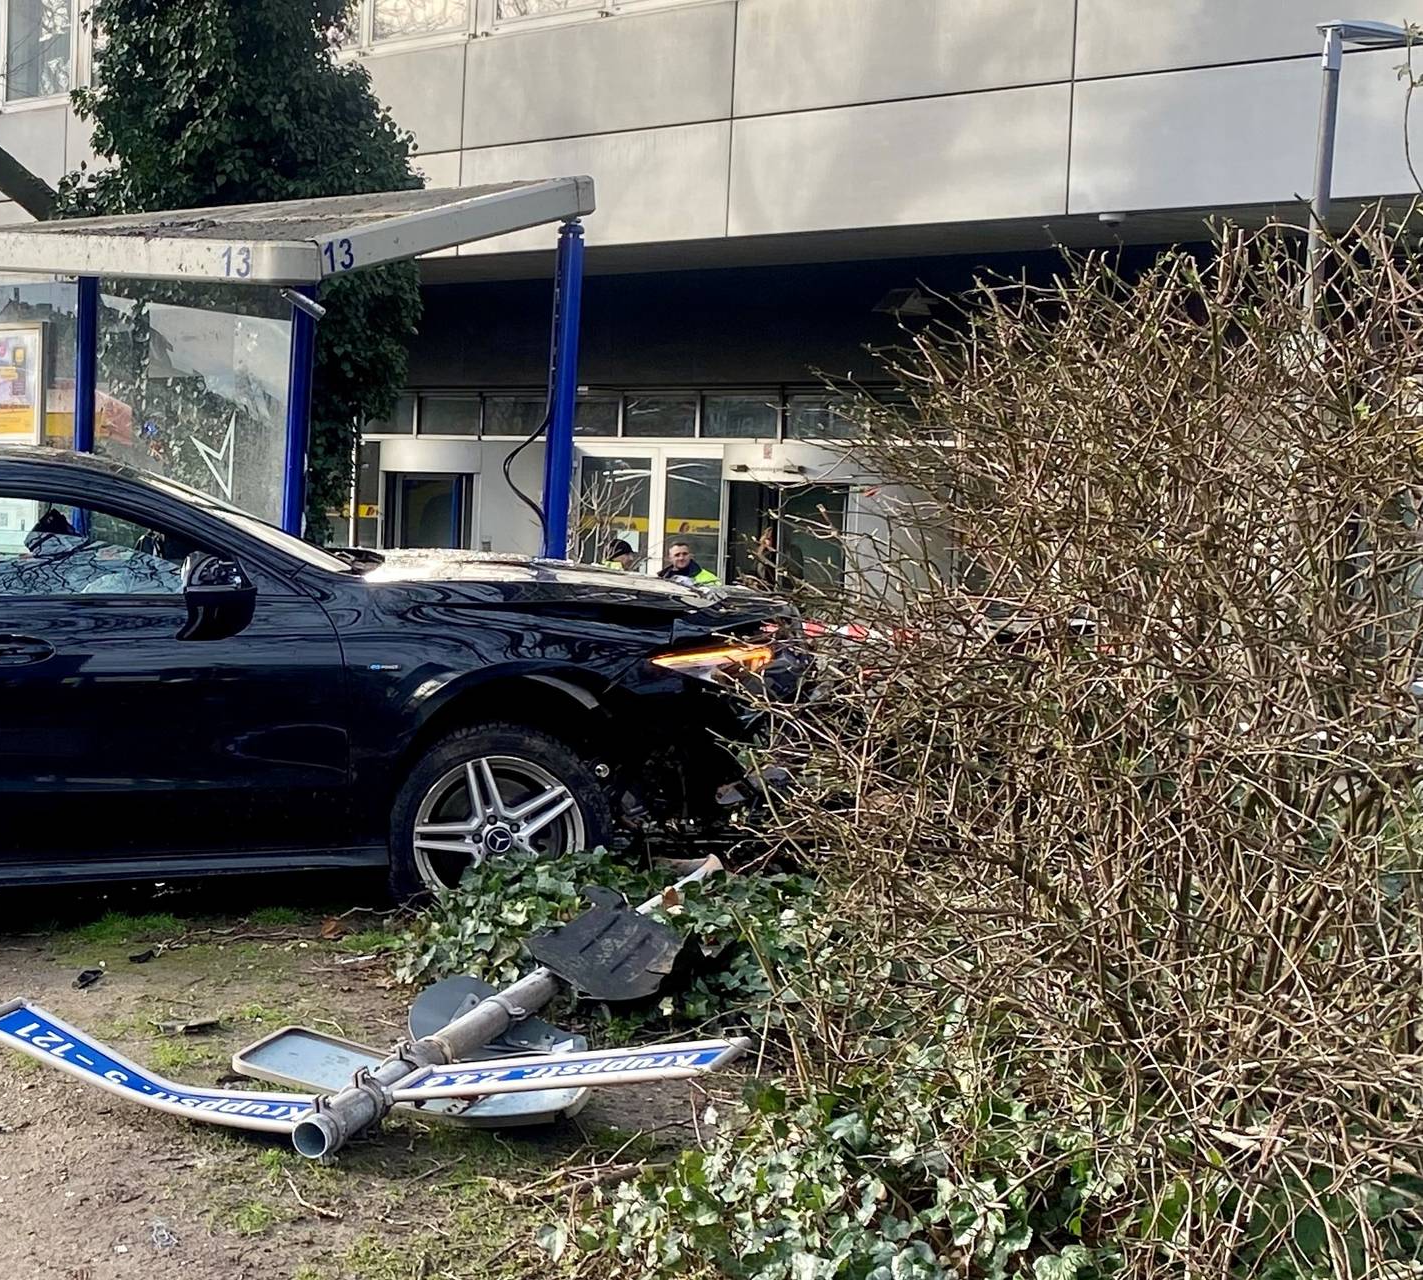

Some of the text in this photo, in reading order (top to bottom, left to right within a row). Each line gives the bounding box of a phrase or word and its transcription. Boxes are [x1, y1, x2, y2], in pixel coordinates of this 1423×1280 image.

[222, 246, 251, 277] 13
[324, 239, 354, 272] 13
[15, 1022, 67, 1059] 121
[524, 1053, 701, 1080] Kruppstr.
[143, 1084, 315, 1121] Kruppstr.
